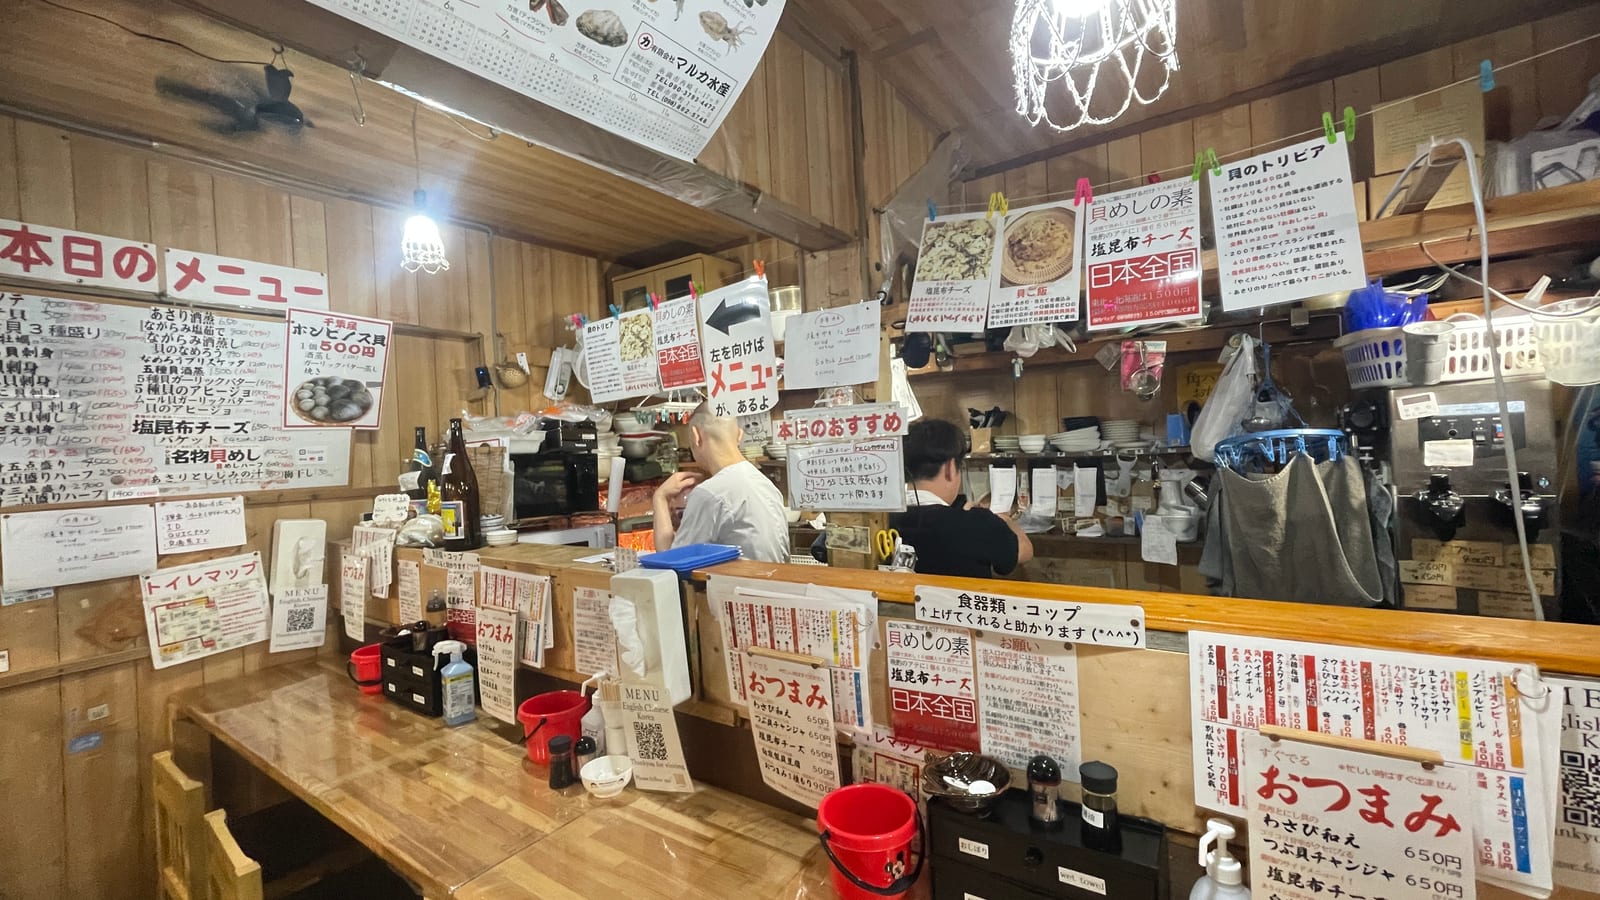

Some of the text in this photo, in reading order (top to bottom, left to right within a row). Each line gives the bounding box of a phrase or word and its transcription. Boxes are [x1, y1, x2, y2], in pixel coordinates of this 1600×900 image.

[651, 45, 675, 64] 有限会社
[676, 56, 731, 97] マルカ水産
[647, 88, 660, 99] TEL
[1228, 144, 1325, 181] 貝のトリビア
[1090, 188, 1192, 224] 貝めしの素
[1091, 226, 1194, 256] 塩昆布チーズ
[0, 225, 324, 303] 本日の メニュー
[1091, 250, 1196, 288] 日本全国
[926, 286, 972, 295] 塩昆布チーズ
[1016, 286, 1048, 298] 貝ご飯
[655, 302, 694, 322] 貝めしの素
[0, 320, 100, 339] 貝3種盛り
[292, 323, 386, 347] ホンビノス貝
[657, 329, 696, 345] 塩昆布チーズ
[0, 347, 54, 359] 貝刺身
[320, 341, 375, 358] 500円
[658, 345, 699, 365] 日本全国
[710, 336, 765, 363] 左を向けば
[0, 375, 50, 388] 貝刺身
[134, 384, 251, 398] 5種貝のアヒージョ
[711, 361, 773, 399] メニュー
[146, 404, 231, 416] 貝のアヒージョ
[715, 396, 769, 417] が、あるよ
[132, 419, 251, 435] 塩昆布チーズ
[778, 412, 901, 440] 本日のおすすめ
[171, 449, 261, 464] 名物貝めし
[152, 469, 265, 485] あさりとしじみの汁
[147, 561, 258, 594] トイレマップ
[285, 588, 320, 597] MENU
[958, 593, 1081, 621] 食器類・コップ
[478, 620, 513, 644] おつまみ
[930, 608, 1086, 641] 上げてくれると助かります
[888, 630, 970, 657] 貝めしの素
[1000, 637, 1040, 651] お願い
[749, 671, 828, 709] おつまみ
[891, 667, 973, 691] 塩昆布チーズ
[1322, 658, 1331, 702] さんぴんハイ
[1331, 658, 1339, 702] ウーロンハイ
[1379, 664, 1389, 711] プレーンサワー
[1408, 667, 1418, 717] マンゴーサワー
[625, 688, 660, 702] MENU
[892, 688, 976, 724] 日本全国
[1428, 670, 1439, 723] 生レモンサワー
[1472, 673, 1485, 729] ノンアルビール
[1488, 676, 1503, 738] オリオンビール
[753, 700, 792, 719] わさび和え
[754, 714, 805, 736] つぶ貝チャンジャ
[758, 732, 805, 754] 塩昆布チーズ
[1261, 748, 1310, 767] すぐでる
[1219, 767, 1227, 799] 700円
[1257, 764, 1461, 837] おつまみ
[1263, 813, 1462, 870] わさび和え 650円
[1263, 838, 1395, 882] つぶ貝チャンジャ
[1405, 875, 1463, 899] 650円
[1267, 866, 1389, 900] 塩昆布チー
